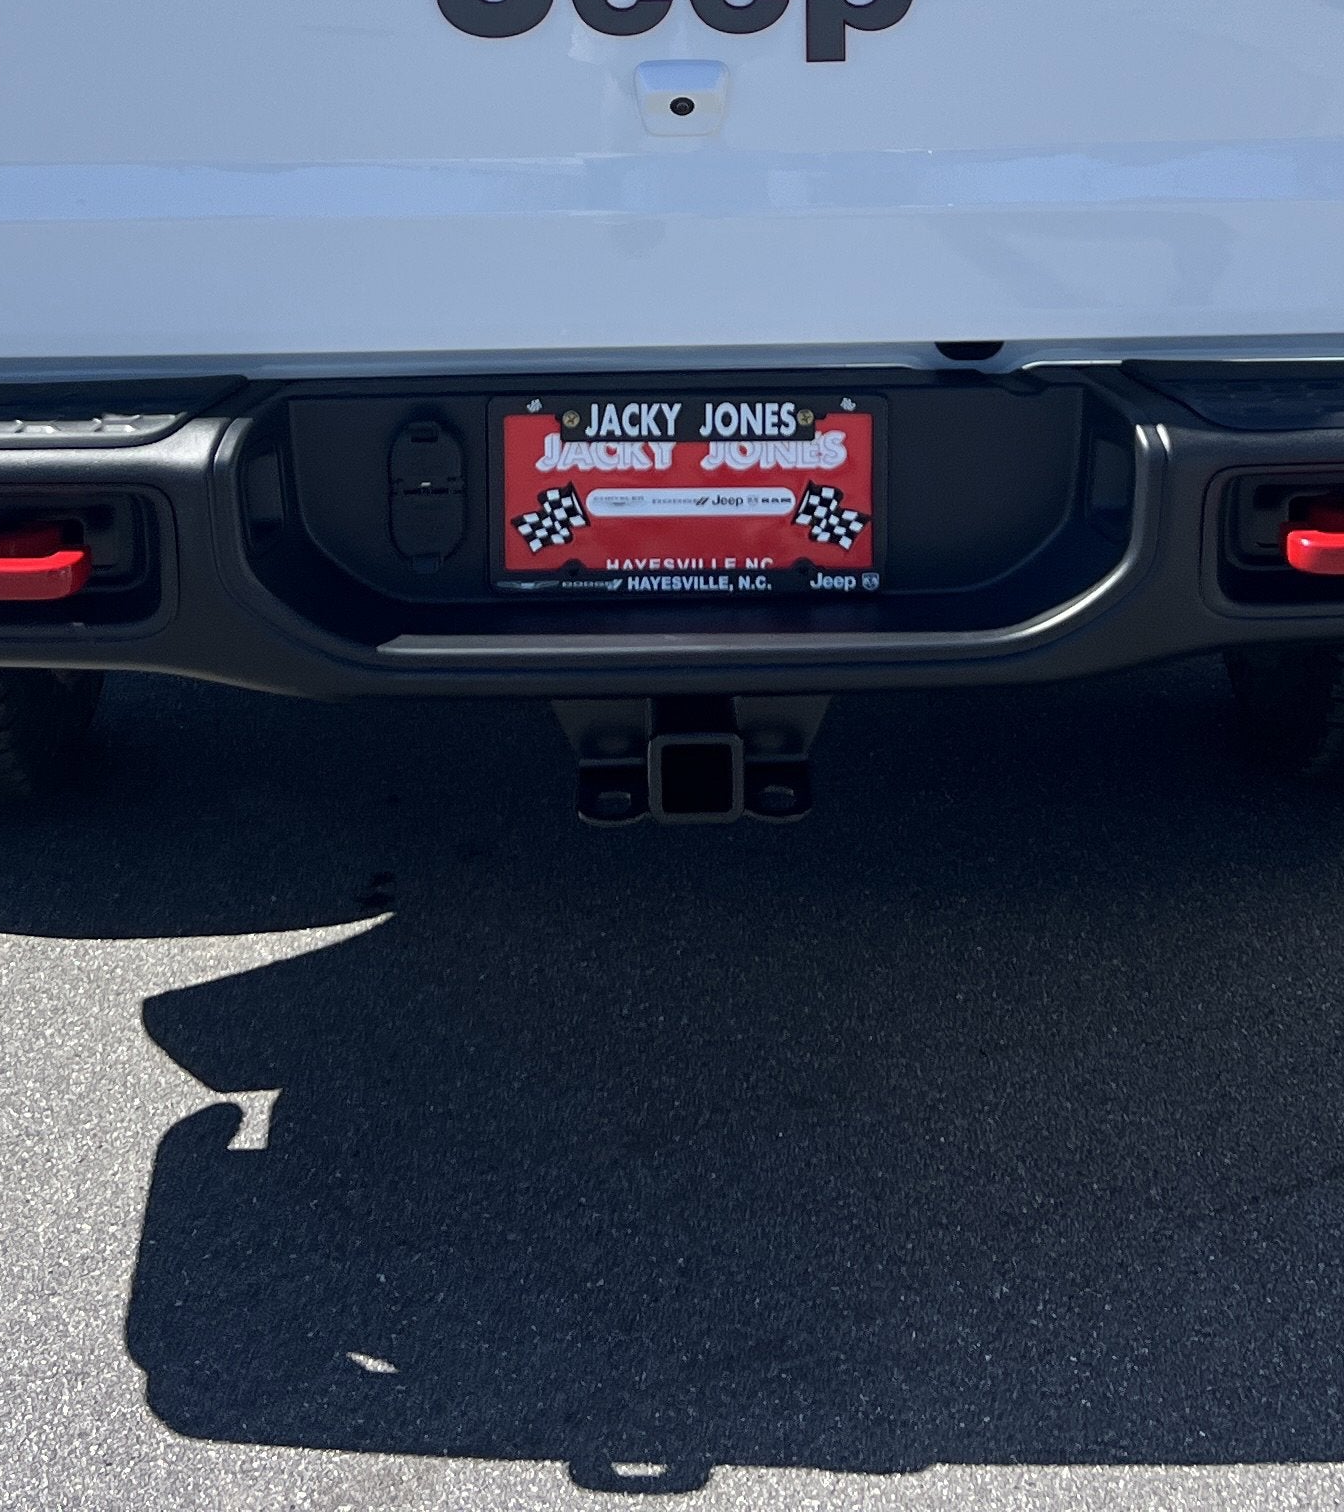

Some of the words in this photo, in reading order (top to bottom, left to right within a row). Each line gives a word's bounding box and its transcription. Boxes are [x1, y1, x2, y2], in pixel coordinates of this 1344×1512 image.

[585, 402, 682, 438] JACKY
[699, 402, 797, 438] JONES
[535, 434, 677, 472] JACKY
[699, 429, 848, 472] JONES
[711, 494, 744, 507] Jeep
[627, 576, 734, 591] HAYESVILLE,
[738, 576, 772, 590] N.C.
[810, 572, 857, 592] Jeep
